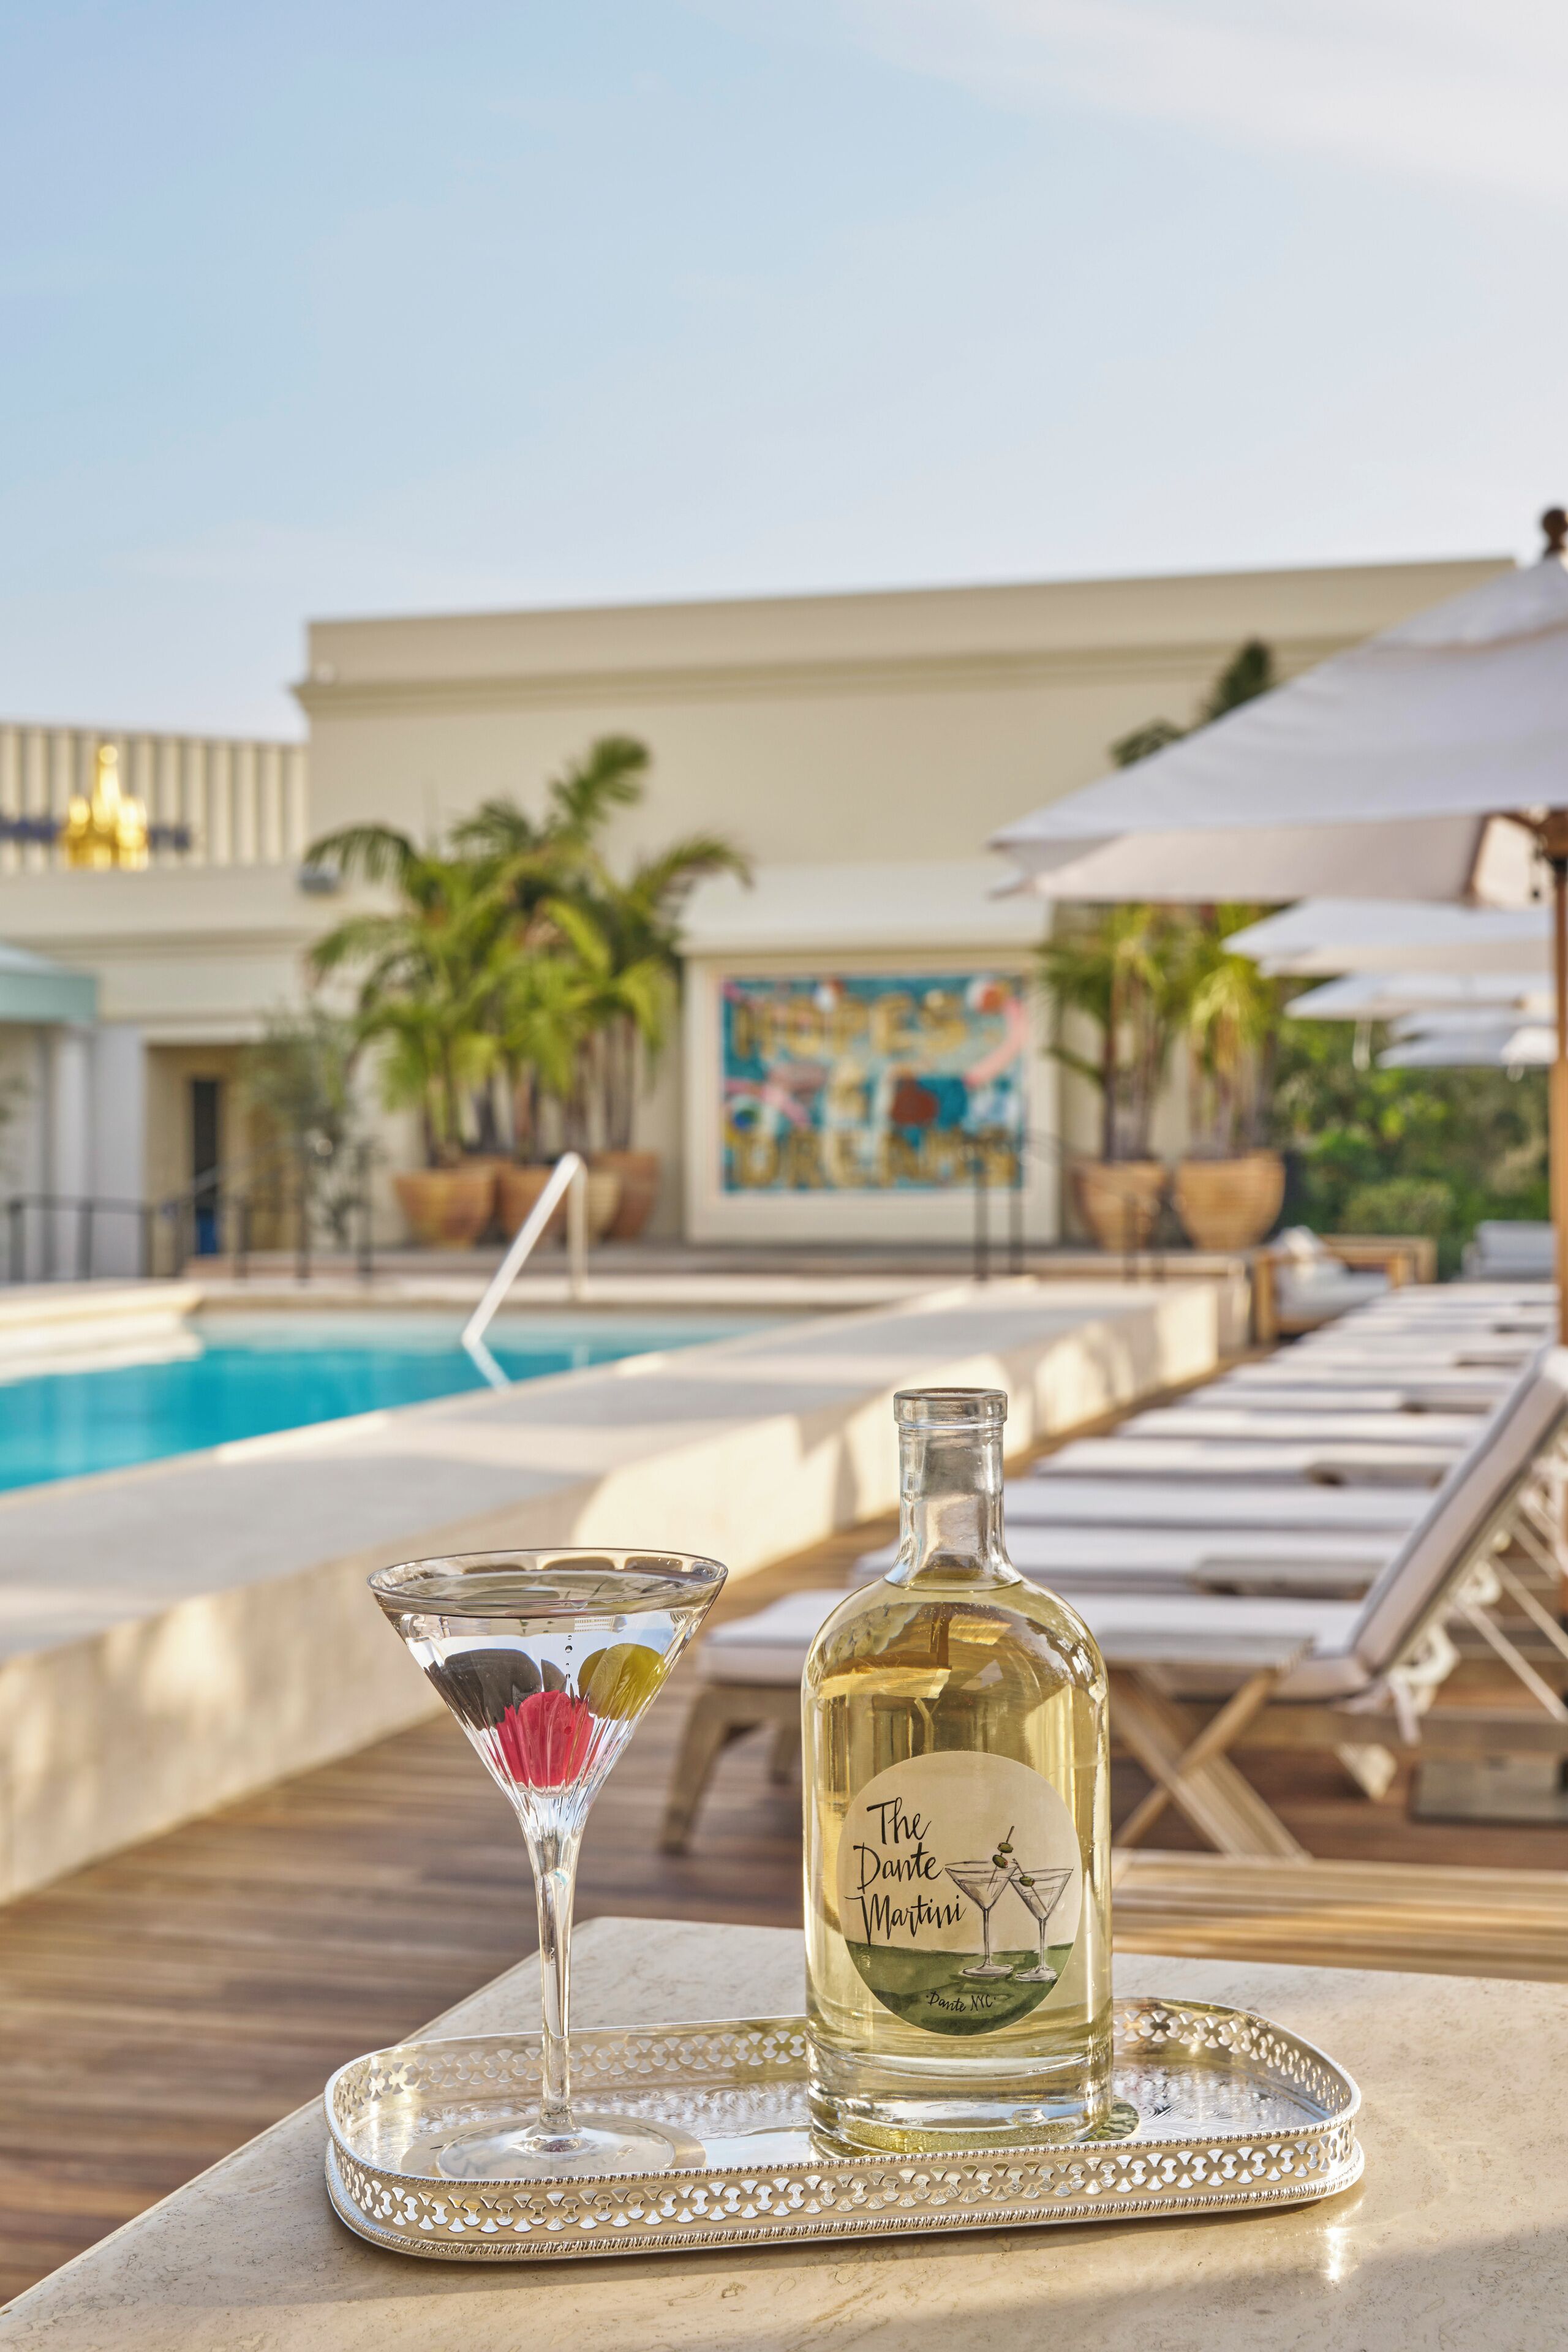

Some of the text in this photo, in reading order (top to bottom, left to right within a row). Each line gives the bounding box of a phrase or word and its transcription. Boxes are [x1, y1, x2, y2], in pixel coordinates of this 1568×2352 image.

[733, 991, 967, 1059] HOPES
[867, 1797, 932, 1845] The
[853, 1842, 944, 1894] Dante
[845, 1894, 967, 1947] Martini
[927, 1991, 993, 2013] Dante NYC
